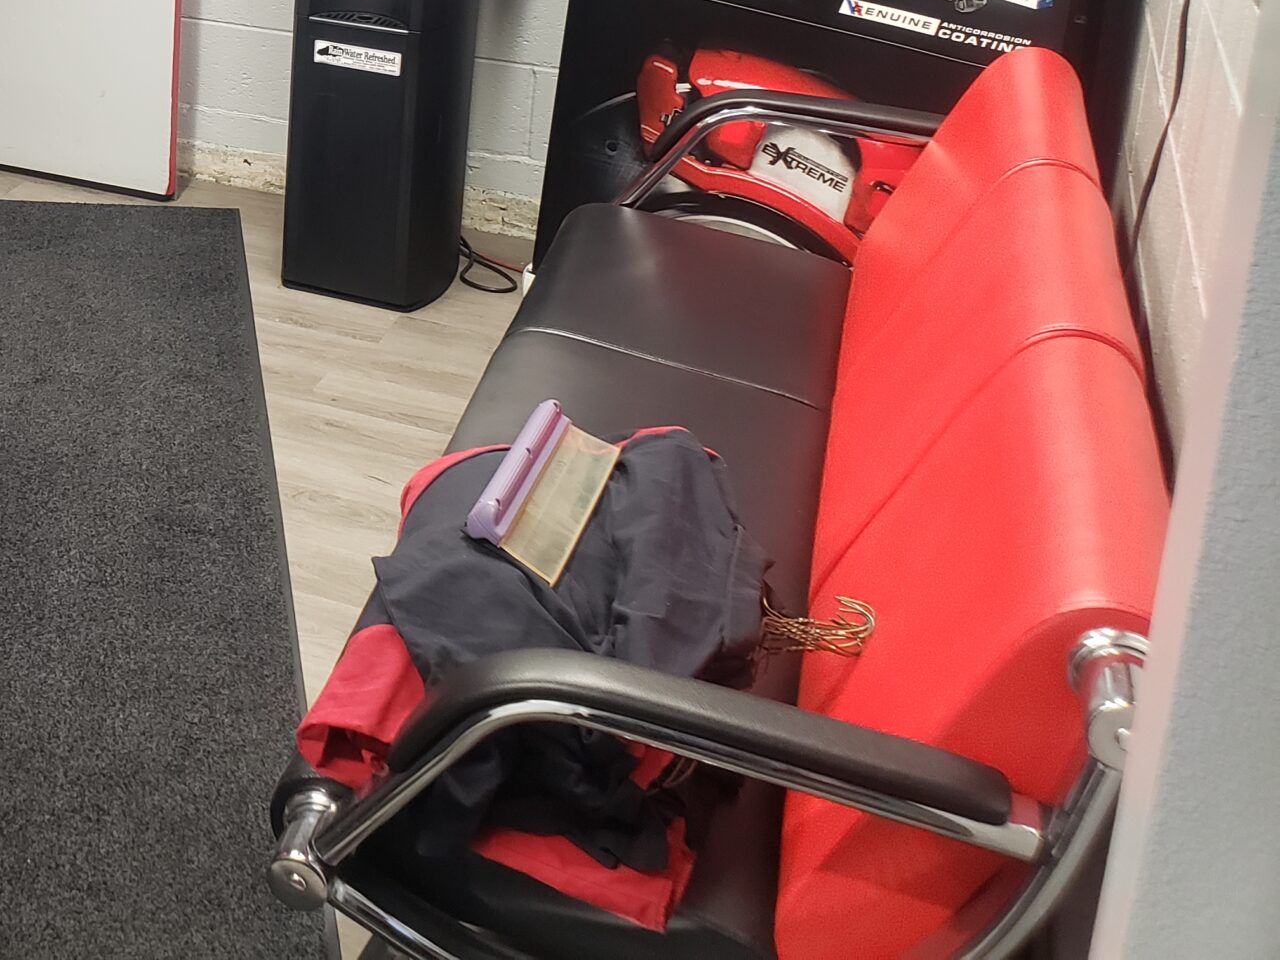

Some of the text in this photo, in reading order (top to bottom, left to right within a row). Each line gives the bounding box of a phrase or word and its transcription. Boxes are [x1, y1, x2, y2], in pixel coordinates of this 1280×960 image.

[937, 28, 1026, 53] COATIN
[941, 22, 1032, 46] ANTICORROSION
[363, 51, 396, 65] Refreshed
